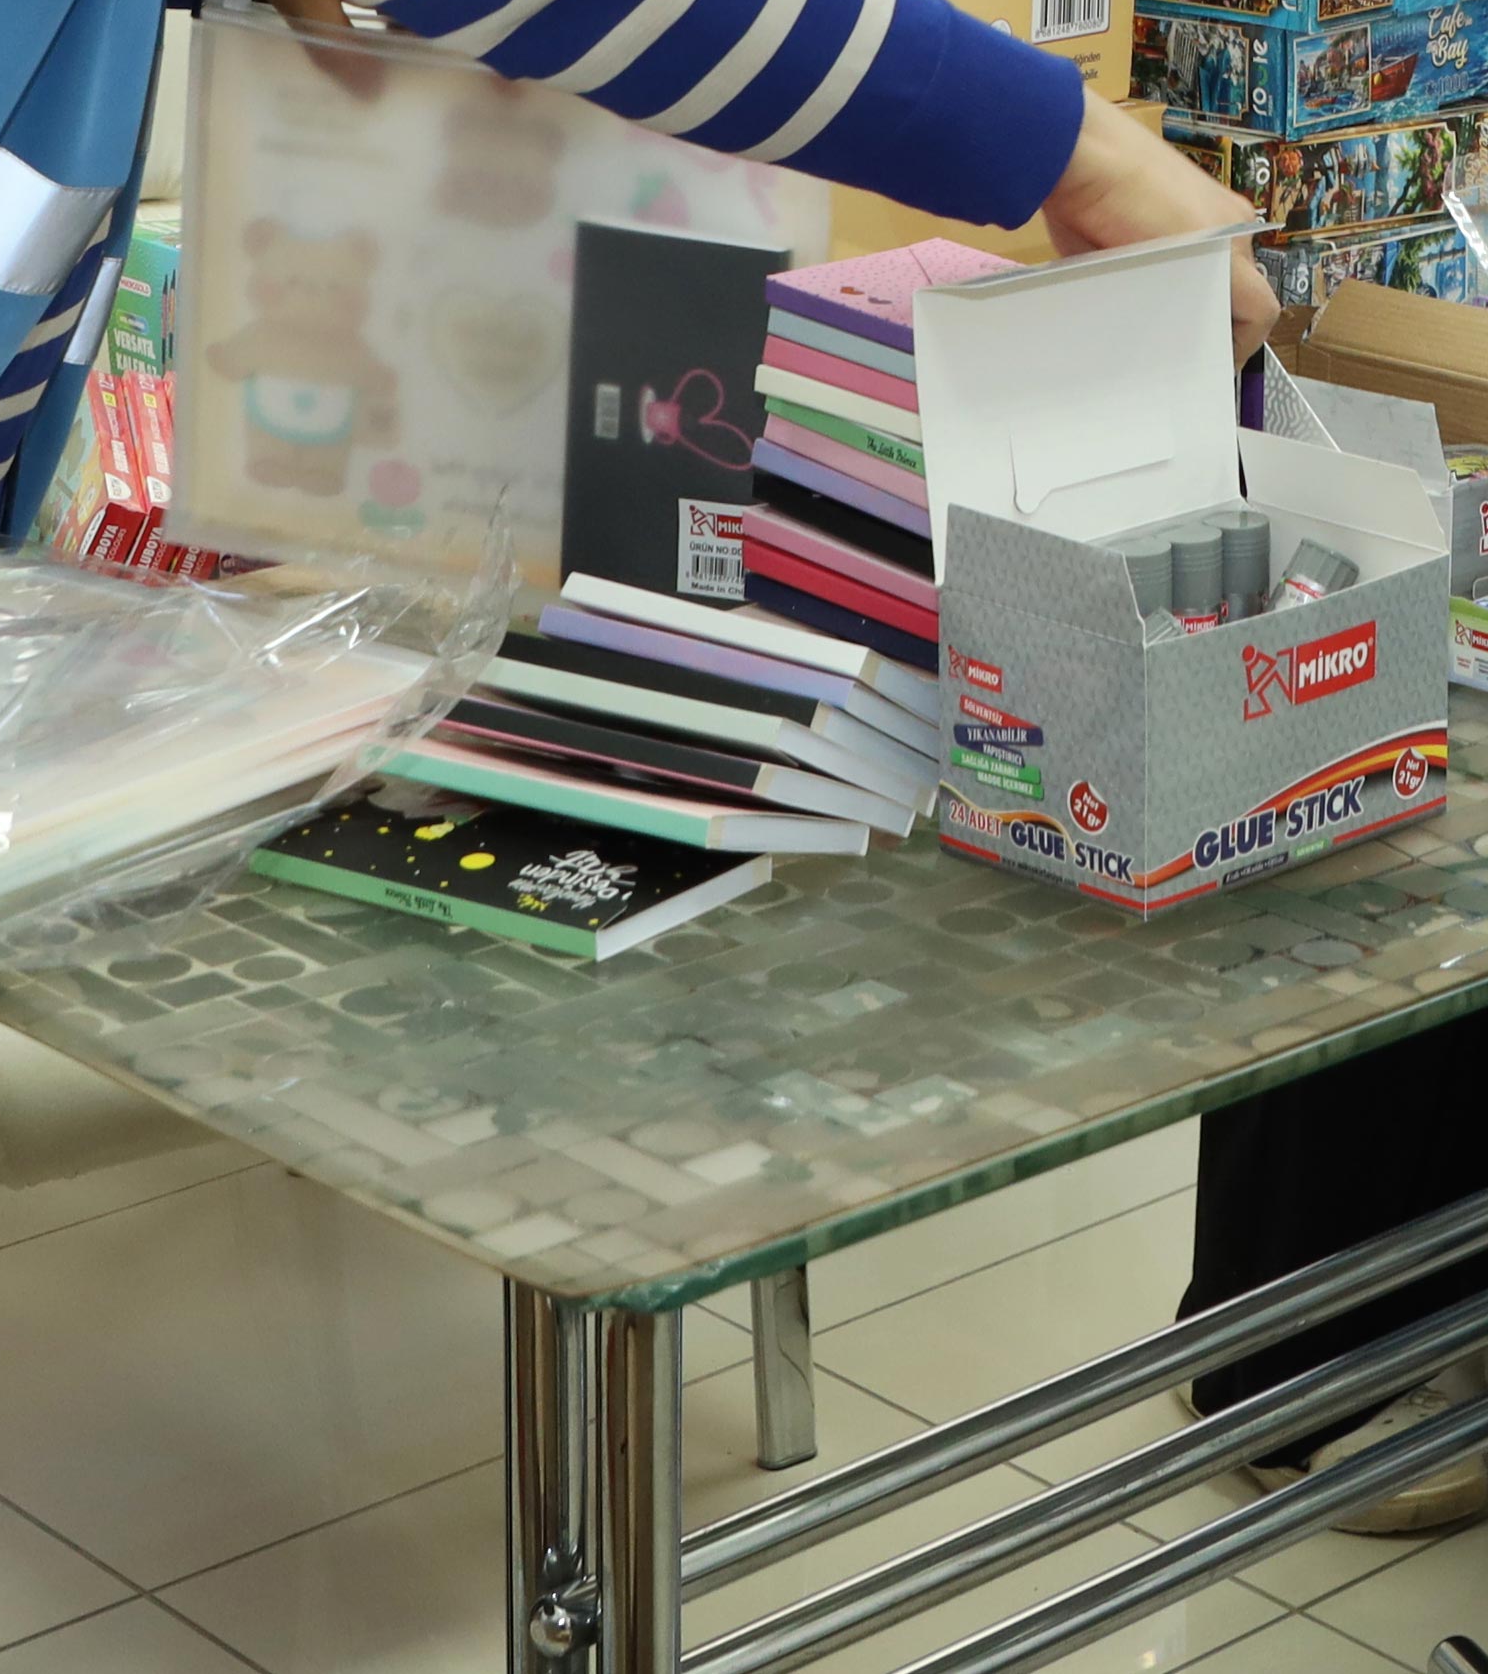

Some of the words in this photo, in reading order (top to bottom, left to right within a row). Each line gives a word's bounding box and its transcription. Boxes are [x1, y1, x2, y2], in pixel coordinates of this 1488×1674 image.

[1427, 3, 1465, 39] Cafe
[1431, 35, 1469, 69] Bay
[1298, 642, 1369, 689] MİKRO
[1406, 757, 1420, 772] Net
[950, 801, 967, 823] 24
[969, 808, 1003, 836] ADET
[1082, 792, 1100, 811] Net
[1193, 809, 1277, 870] GLUE
[1285, 776, 1365, 839] STICK
[1010, 821, 1066, 861] GLUE
[1075, 841, 1134, 886] STICK
